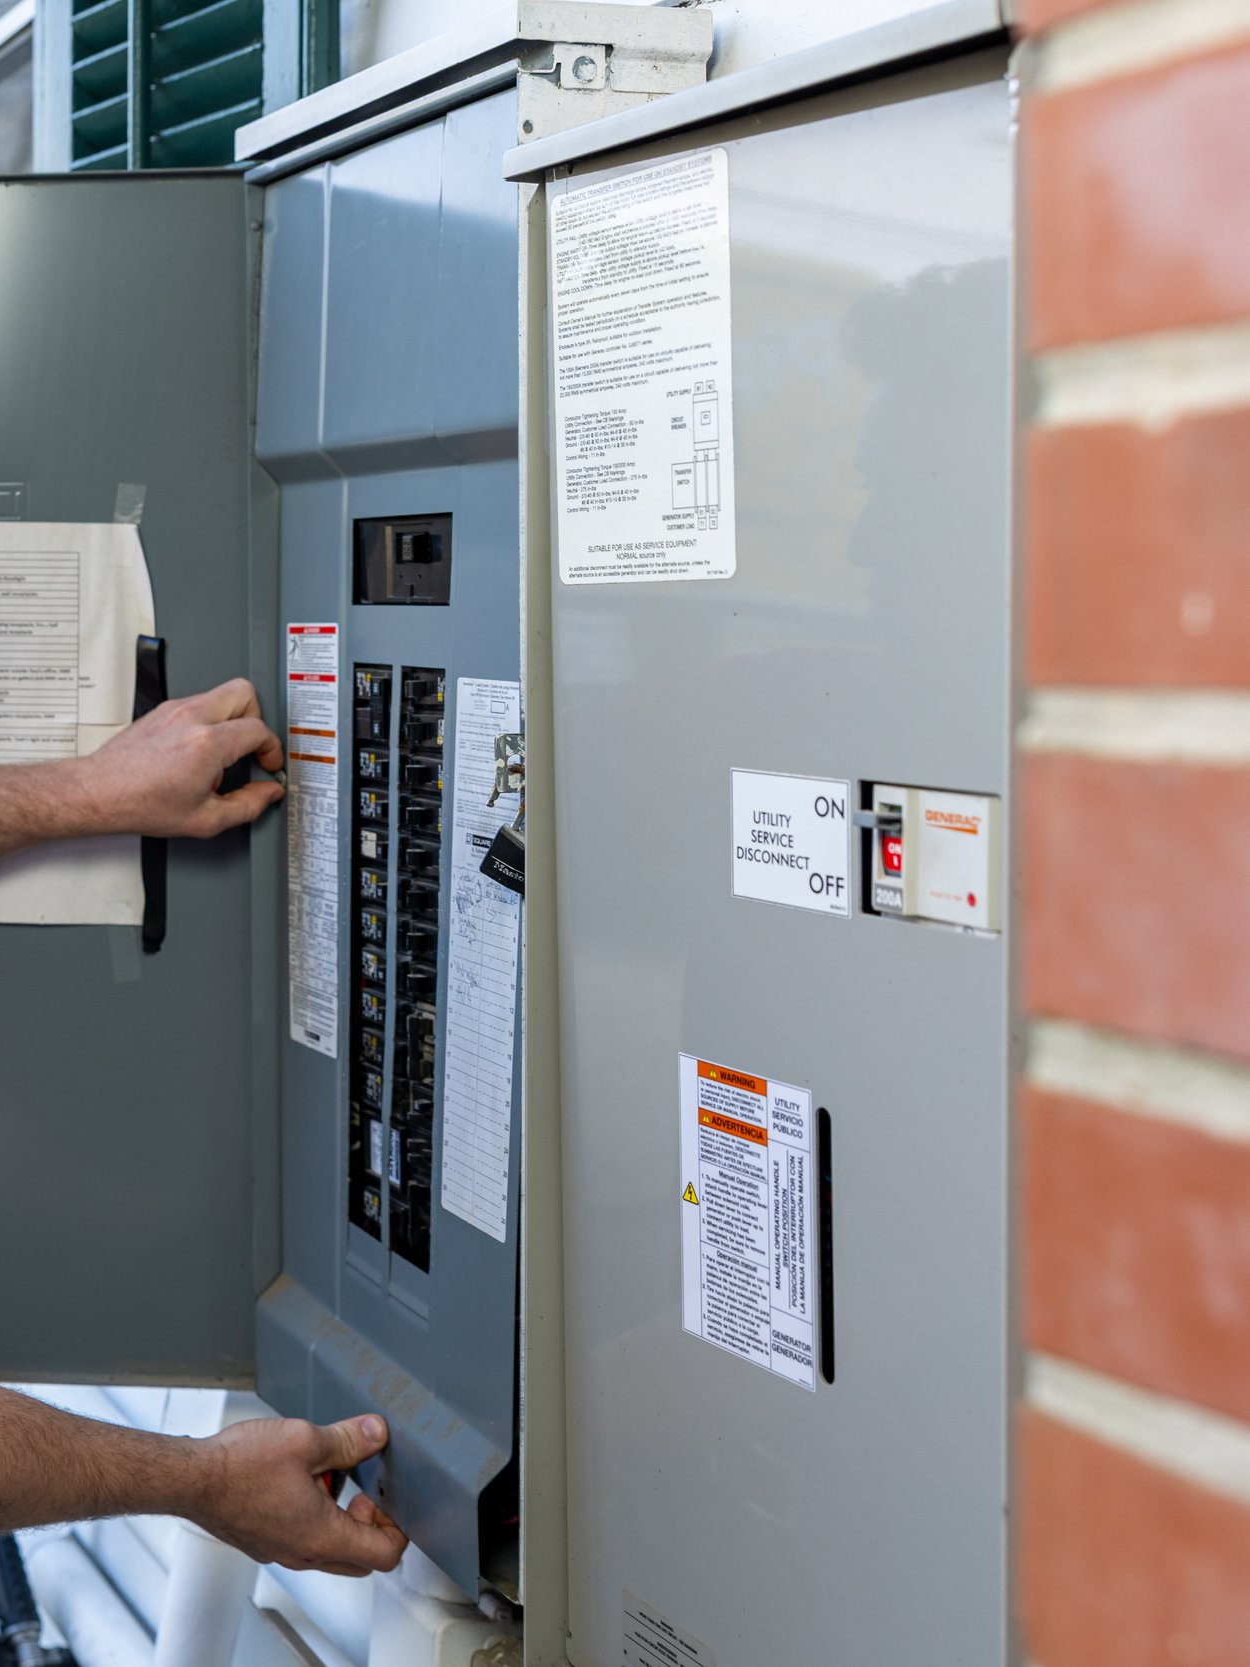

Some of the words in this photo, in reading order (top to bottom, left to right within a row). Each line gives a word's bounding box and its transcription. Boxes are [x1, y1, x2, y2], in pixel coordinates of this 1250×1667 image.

[560, 191, 586, 204] AUTOMATIC
[586, 184, 611, 197] TRANSFER
[612, 178, 631, 190] SWITCH
[632, 175, 642, 184] FOR
[643, 172, 653, 181] USE
[654, 169, 661, 178] ON
[662, 162, 686, 176] STANDBY
[687, 155, 711, 169] SYSTEMS
[587, 544, 610, 553] SUITABLE
[642, 540, 664, 549] SERVICE
[665, 538, 696, 548] EQUIPMENT
[616, 552, 638, 560] NORMAL
[655, 550, 666, 559] only
[815, 796, 845, 819] ON
[753, 811, 791, 828] UTILITY
[926, 810, 981, 827] GENERAC
[473, 837, 491, 846] SQUARE
[751, 830, 794, 848] SERVICE
[888, 842, 902, 855] ON
[736, 846, 810, 870] DISCONNECT
[493, 862, 525, 882] Maste
[809, 873, 844, 897] OFF
[876, 888, 902, 908] 200A
[719, 1070, 755, 1089] WARNING
[700, 1093, 718, 1102] SOURCES
[724, 1100, 738, 1109] SUPPLY
[739, 1105, 754, 1114] BEFORE
[701, 1100, 716, 1108] SERVICE
[722, 1106, 738, 1116] MANUAL
[739, 1112, 761, 1123] OPERATION.
[775, 1098, 799, 1112] UTILITY
[711, 1115, 763, 1140] ADVERTENCIA
[772, 1111, 802, 1127] SERVICIO
[773, 1120, 802, 1139] PÚBLICO
[711, 1176, 728, 1188] manually
[729, 1183, 745, 1194] operate
[746, 1189, 760, 1199] switch,
[718, 1170, 735, 1181] Manual
[736, 1176, 758, 1191] Operation
[704, 1182, 717, 1190] attach
[717, 1186, 731, 1196] handle
[737, 1193, 756, 1206] operating
[757, 1201, 767, 1209] lever
[705, 1189, 721, 1199] between
[722, 1196, 739, 1206] solenoid
[740, 1202, 749, 1210] coils.
[706, 1204, 725, 1217] generator
[731, 1214, 741, 1223] push
[742, 1218, 751, 1226] lever
[714, 1200, 724, 1208] down
[725, 1204, 735, 1213] lever
[741, 1210, 758, 1221] connect
[706, 1212, 722, 1223] connect
[723, 1219, 733, 1228] utility
[739, 1225, 749, 1233] load.
[706, 1220, 717, 1228] When
[718, 1224, 736, 1236] servicing
[745, 1235, 755, 1243] been
[706, 1227, 728, 1241] completed,
[750, 1245, 764, 1255] remove
[706, 1235, 719, 1244] handle
[730, 1244, 744, 1254] switch.
[716, 1250, 739, 1266] Operación
[740, 1260, 756, 1272] manual
[799, 1250, 805, 1265] DE
[800, 1301, 805, 1315] LA
[772, 1329, 811, 1353] GENERATOR
[772, 1343, 811, 1367] GENERADOR
